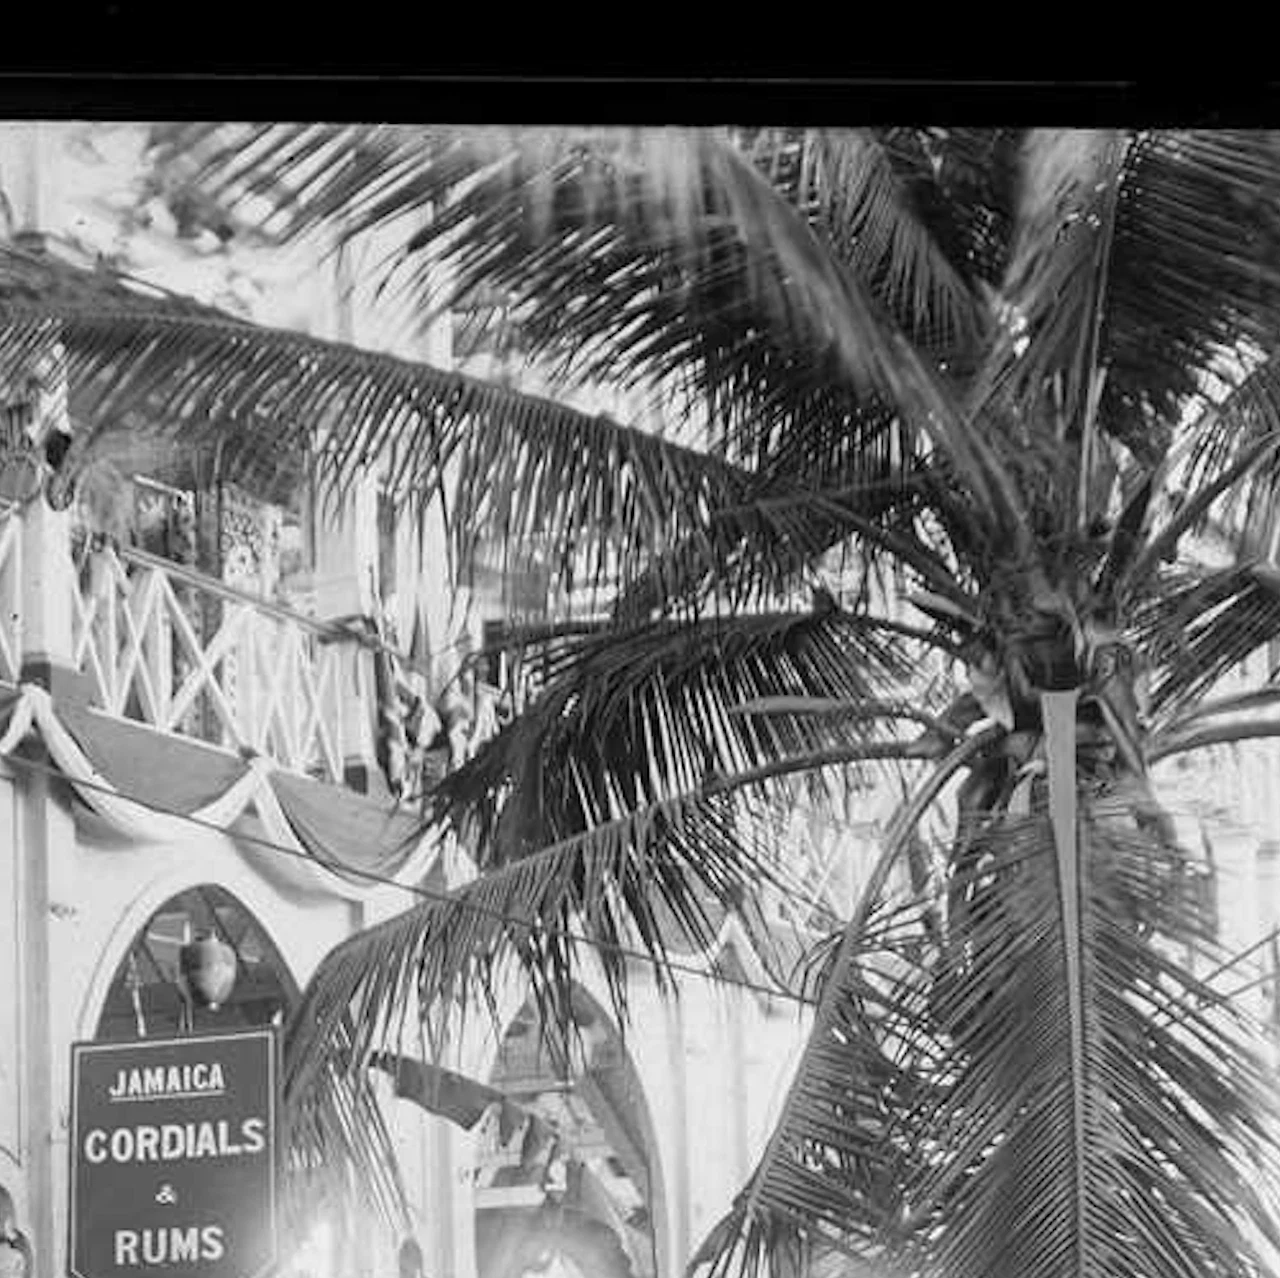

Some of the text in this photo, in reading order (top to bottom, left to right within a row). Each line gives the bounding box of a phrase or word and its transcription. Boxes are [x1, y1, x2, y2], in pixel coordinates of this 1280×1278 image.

[109, 1063, 224, 1097] JAMAICA
[84, 1117, 265, 1163] CORDIALS
[155, 1183, 175, 1205] &
[114, 1226, 225, 1265] RUMS
